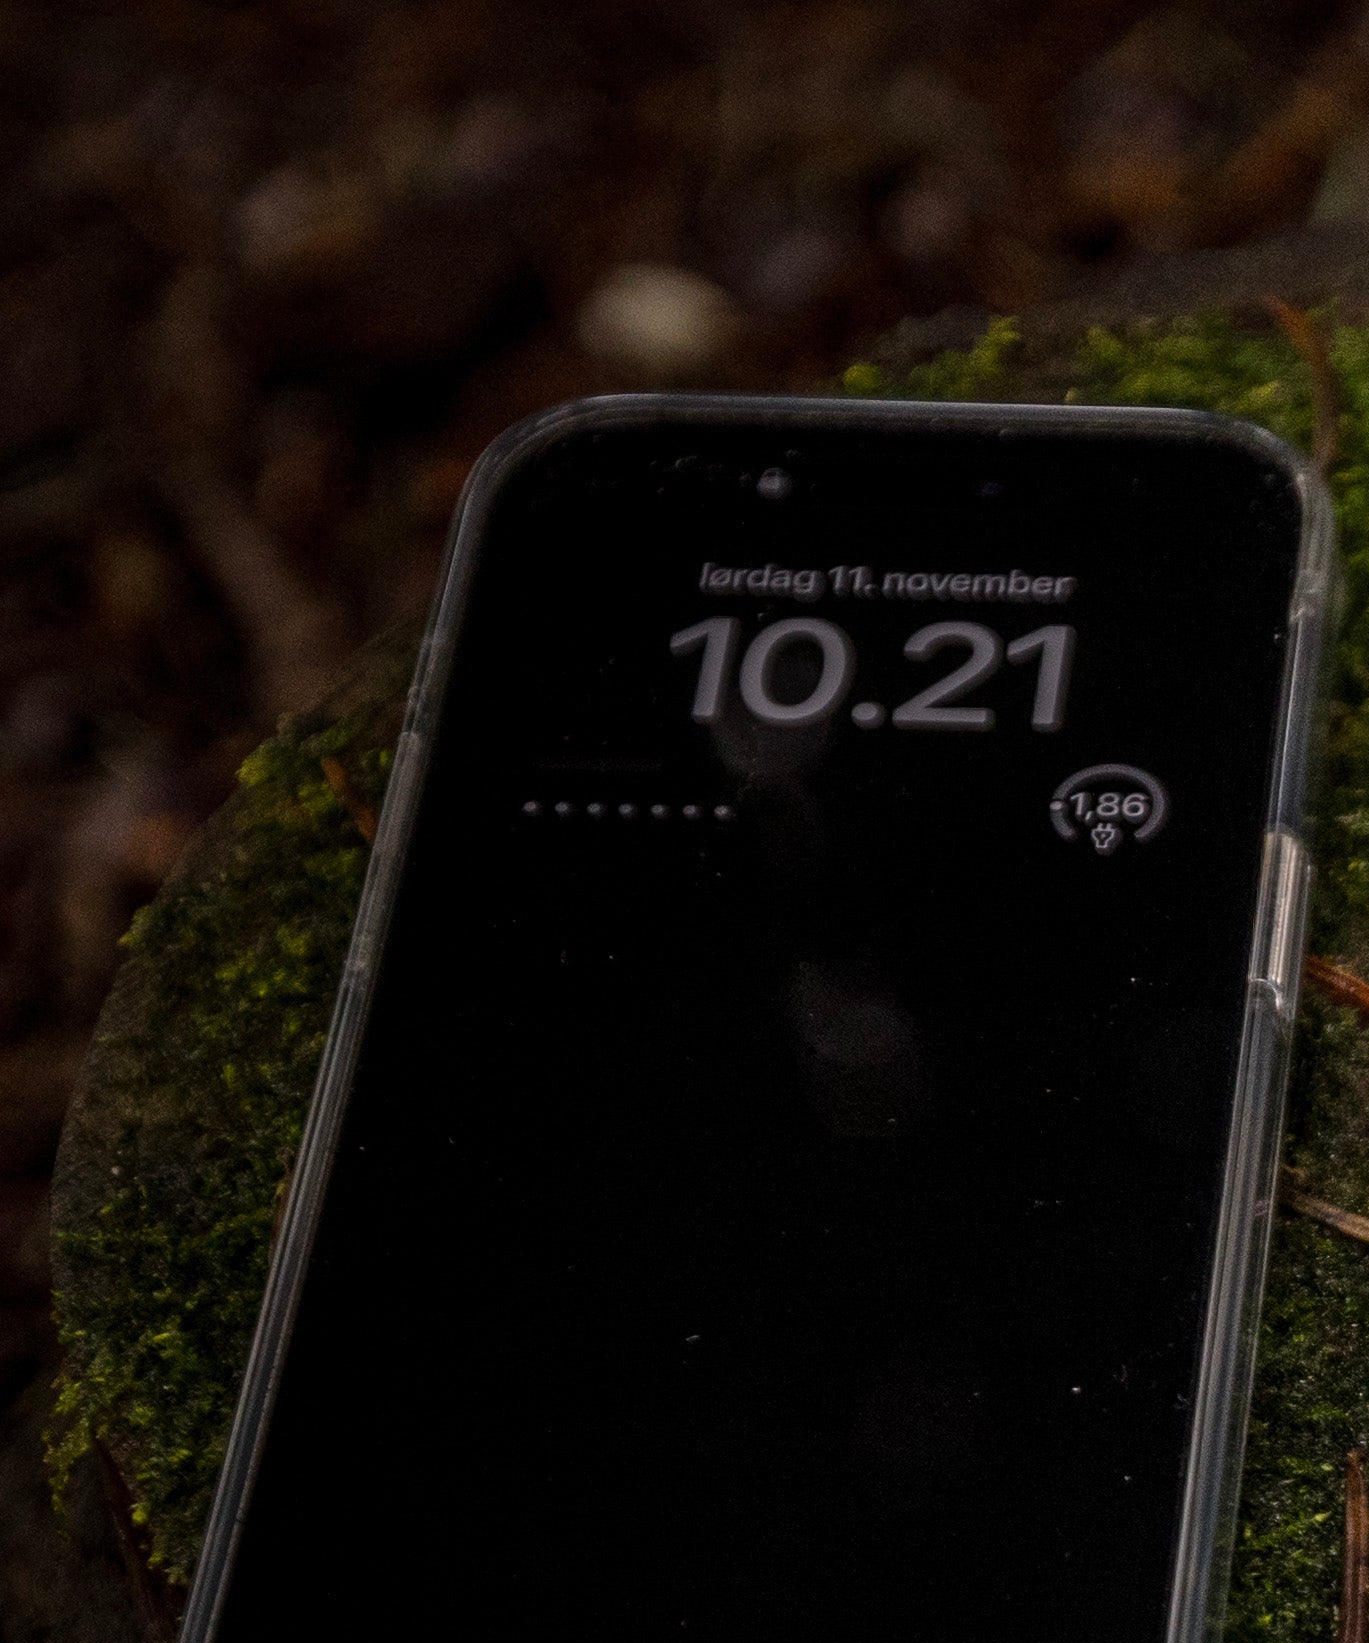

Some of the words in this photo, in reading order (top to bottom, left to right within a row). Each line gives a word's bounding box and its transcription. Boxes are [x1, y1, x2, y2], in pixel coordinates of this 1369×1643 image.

[699, 561, 816, 598] lørdag
[827, 564, 876, 597] 11.
[881, 568, 1076, 600] november
[669, 614, 1076, 731] 10.21
[1069, 792, 1149, 821] 1,86
